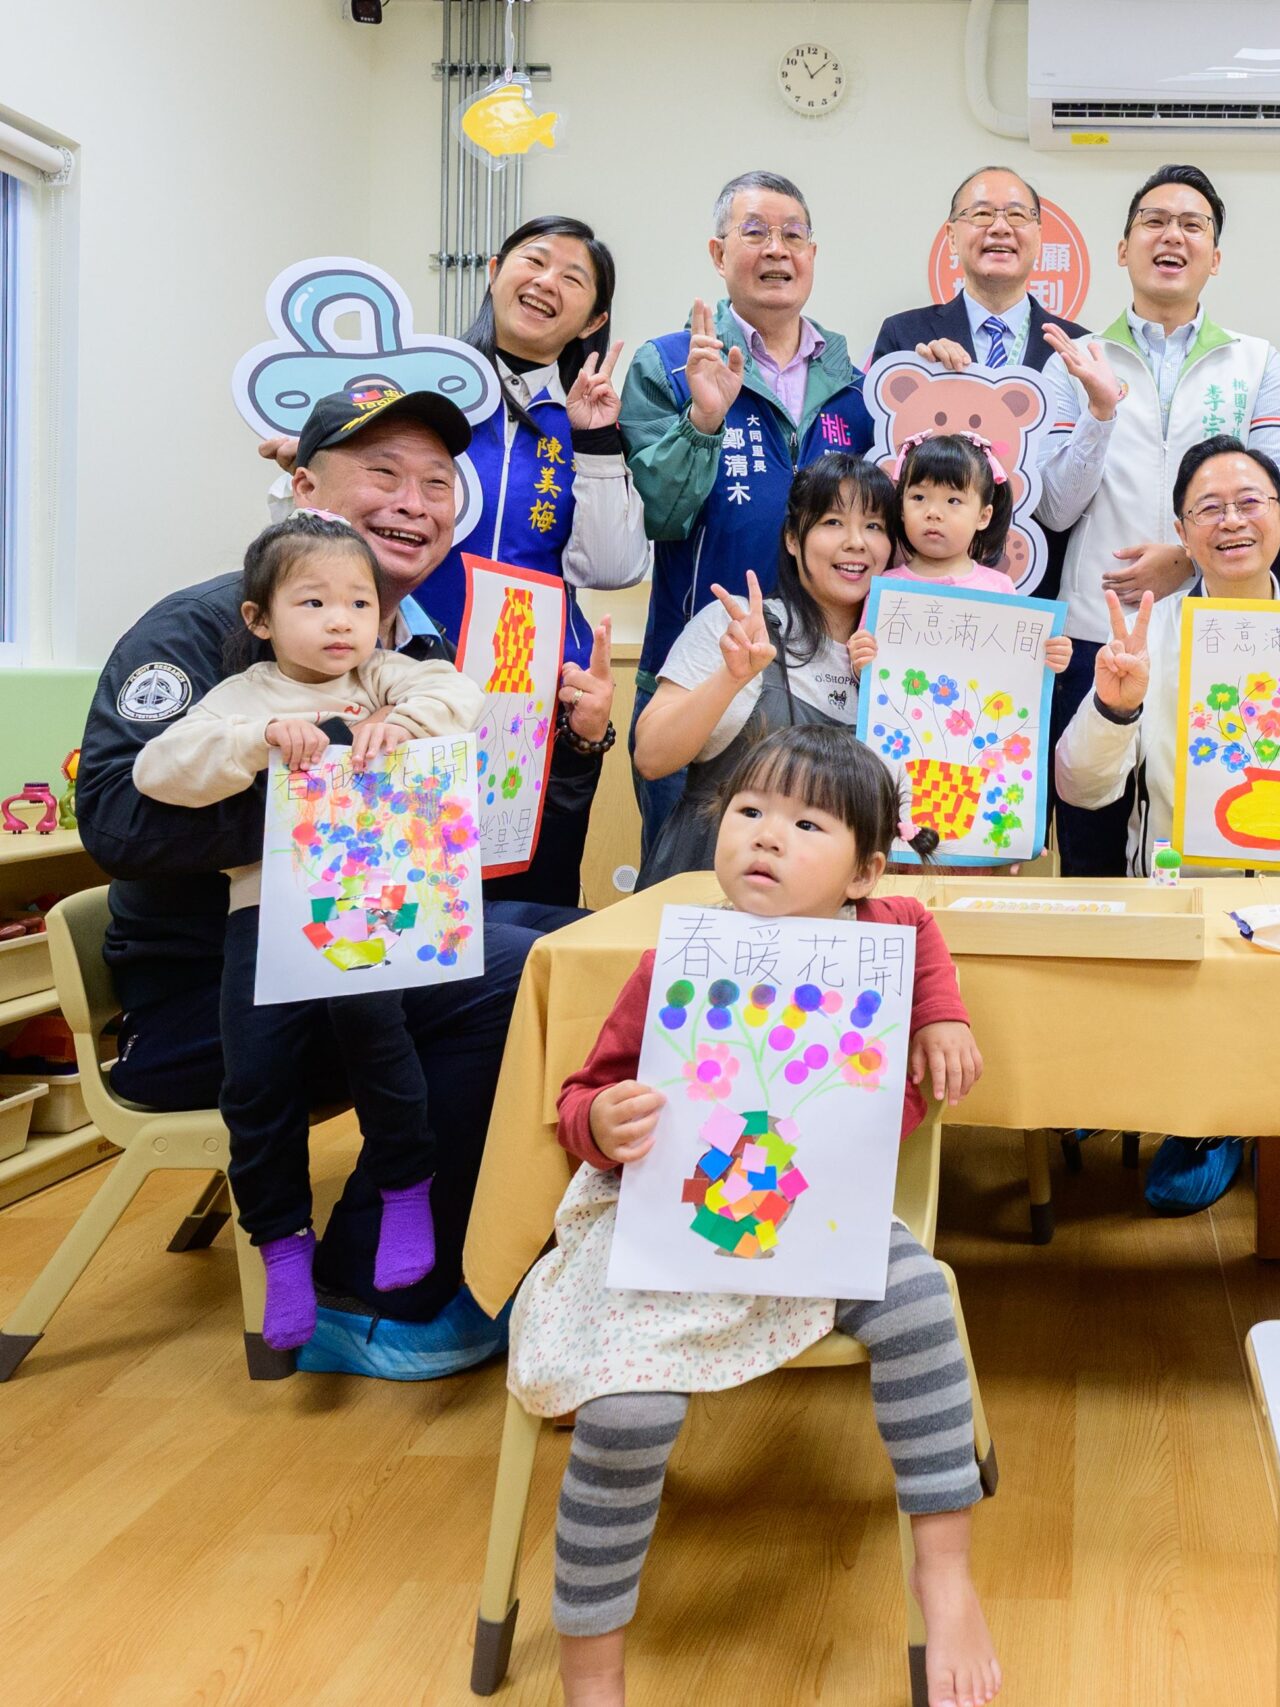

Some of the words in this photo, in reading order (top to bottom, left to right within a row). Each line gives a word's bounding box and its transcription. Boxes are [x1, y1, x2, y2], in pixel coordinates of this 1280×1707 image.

[796, 48, 804, 57] 11
[807, 46, 818, 55] 12
[824, 52, 828, 60] 1
[786, 57, 798, 66] 10
[832, 63, 839, 71] 2
[785, 84, 792, 92] 8
[821, 98, 828, 106] 5
[746, 413, 768, 474] 大同里長
[721, 426, 752, 506] 鄭清木
[528, 435, 566, 534] 陳美梅
[878, 596, 1044, 661] 春意滿人間
[662, 912, 904, 997] 春暖花開
